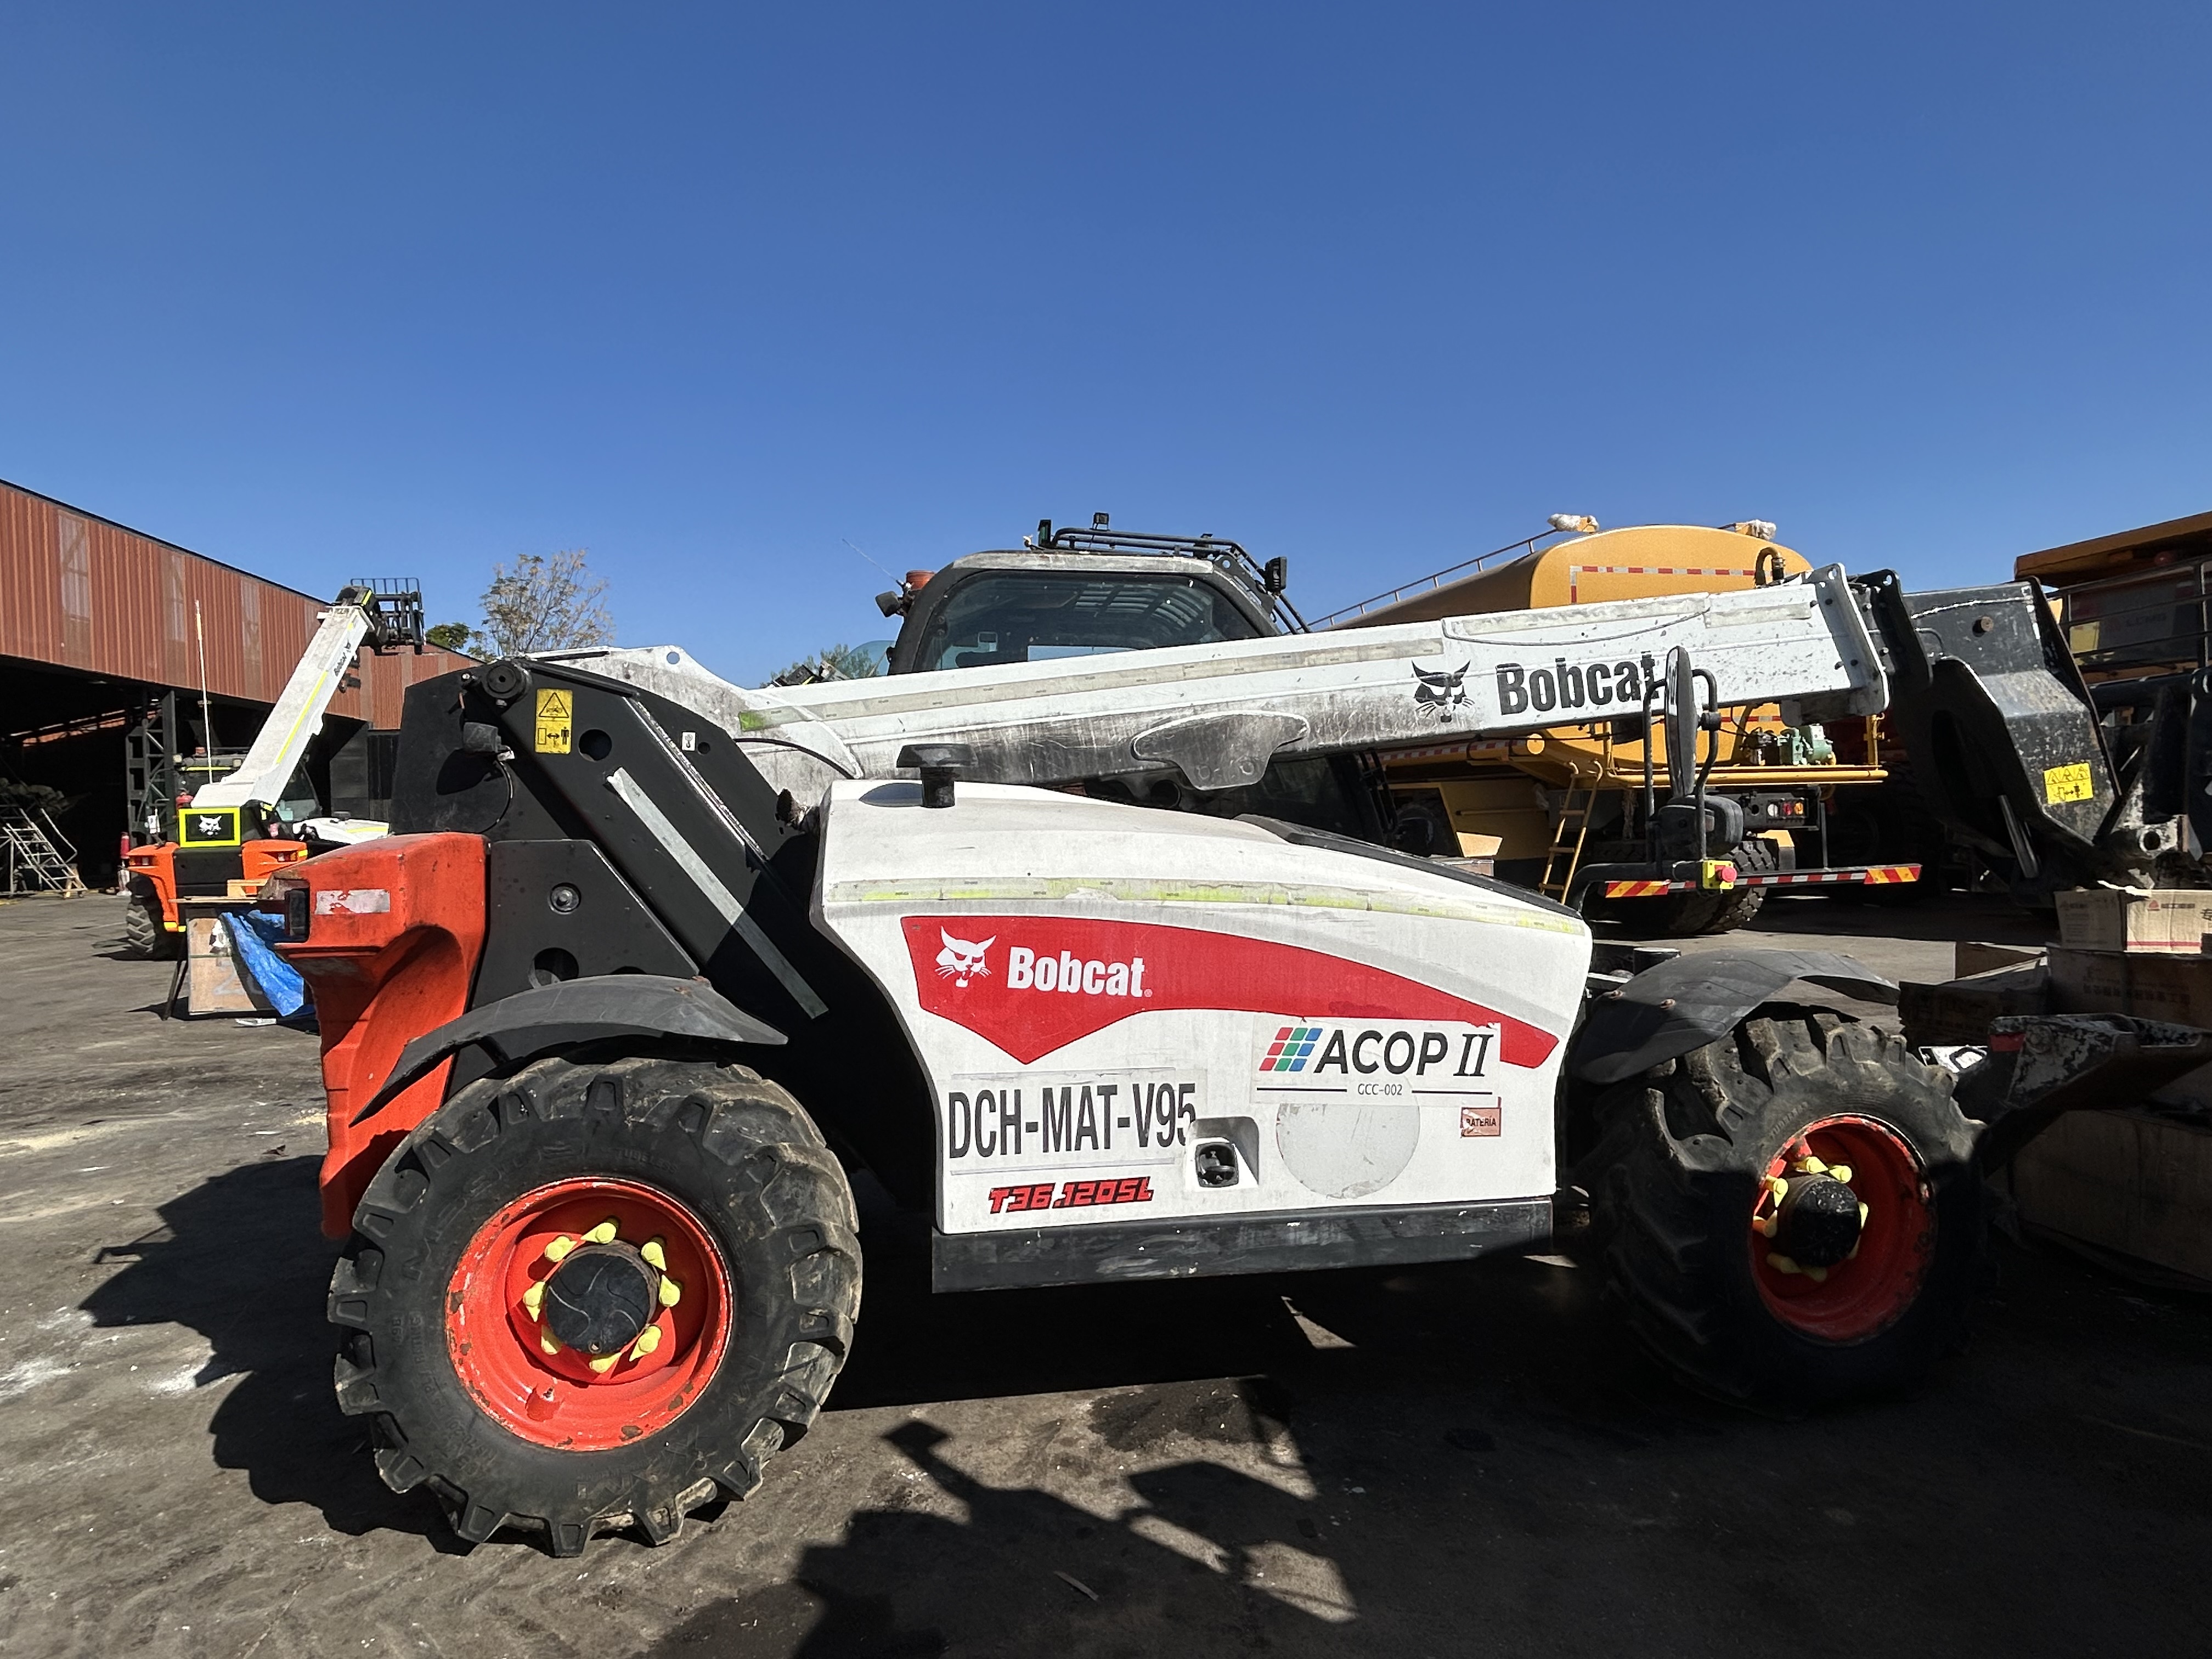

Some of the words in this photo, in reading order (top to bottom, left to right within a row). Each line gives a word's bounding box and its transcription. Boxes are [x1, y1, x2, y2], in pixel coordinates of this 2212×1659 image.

[1495, 651, 1660, 716] Bobcat
[1007, 946, 1145, 997] Bobcat
[1313, 1029, 1449, 1076] ACOP
[1453, 1034, 1494, 1077] II
[948, 1082, 1196, 1159] DCH-MAT-V95
